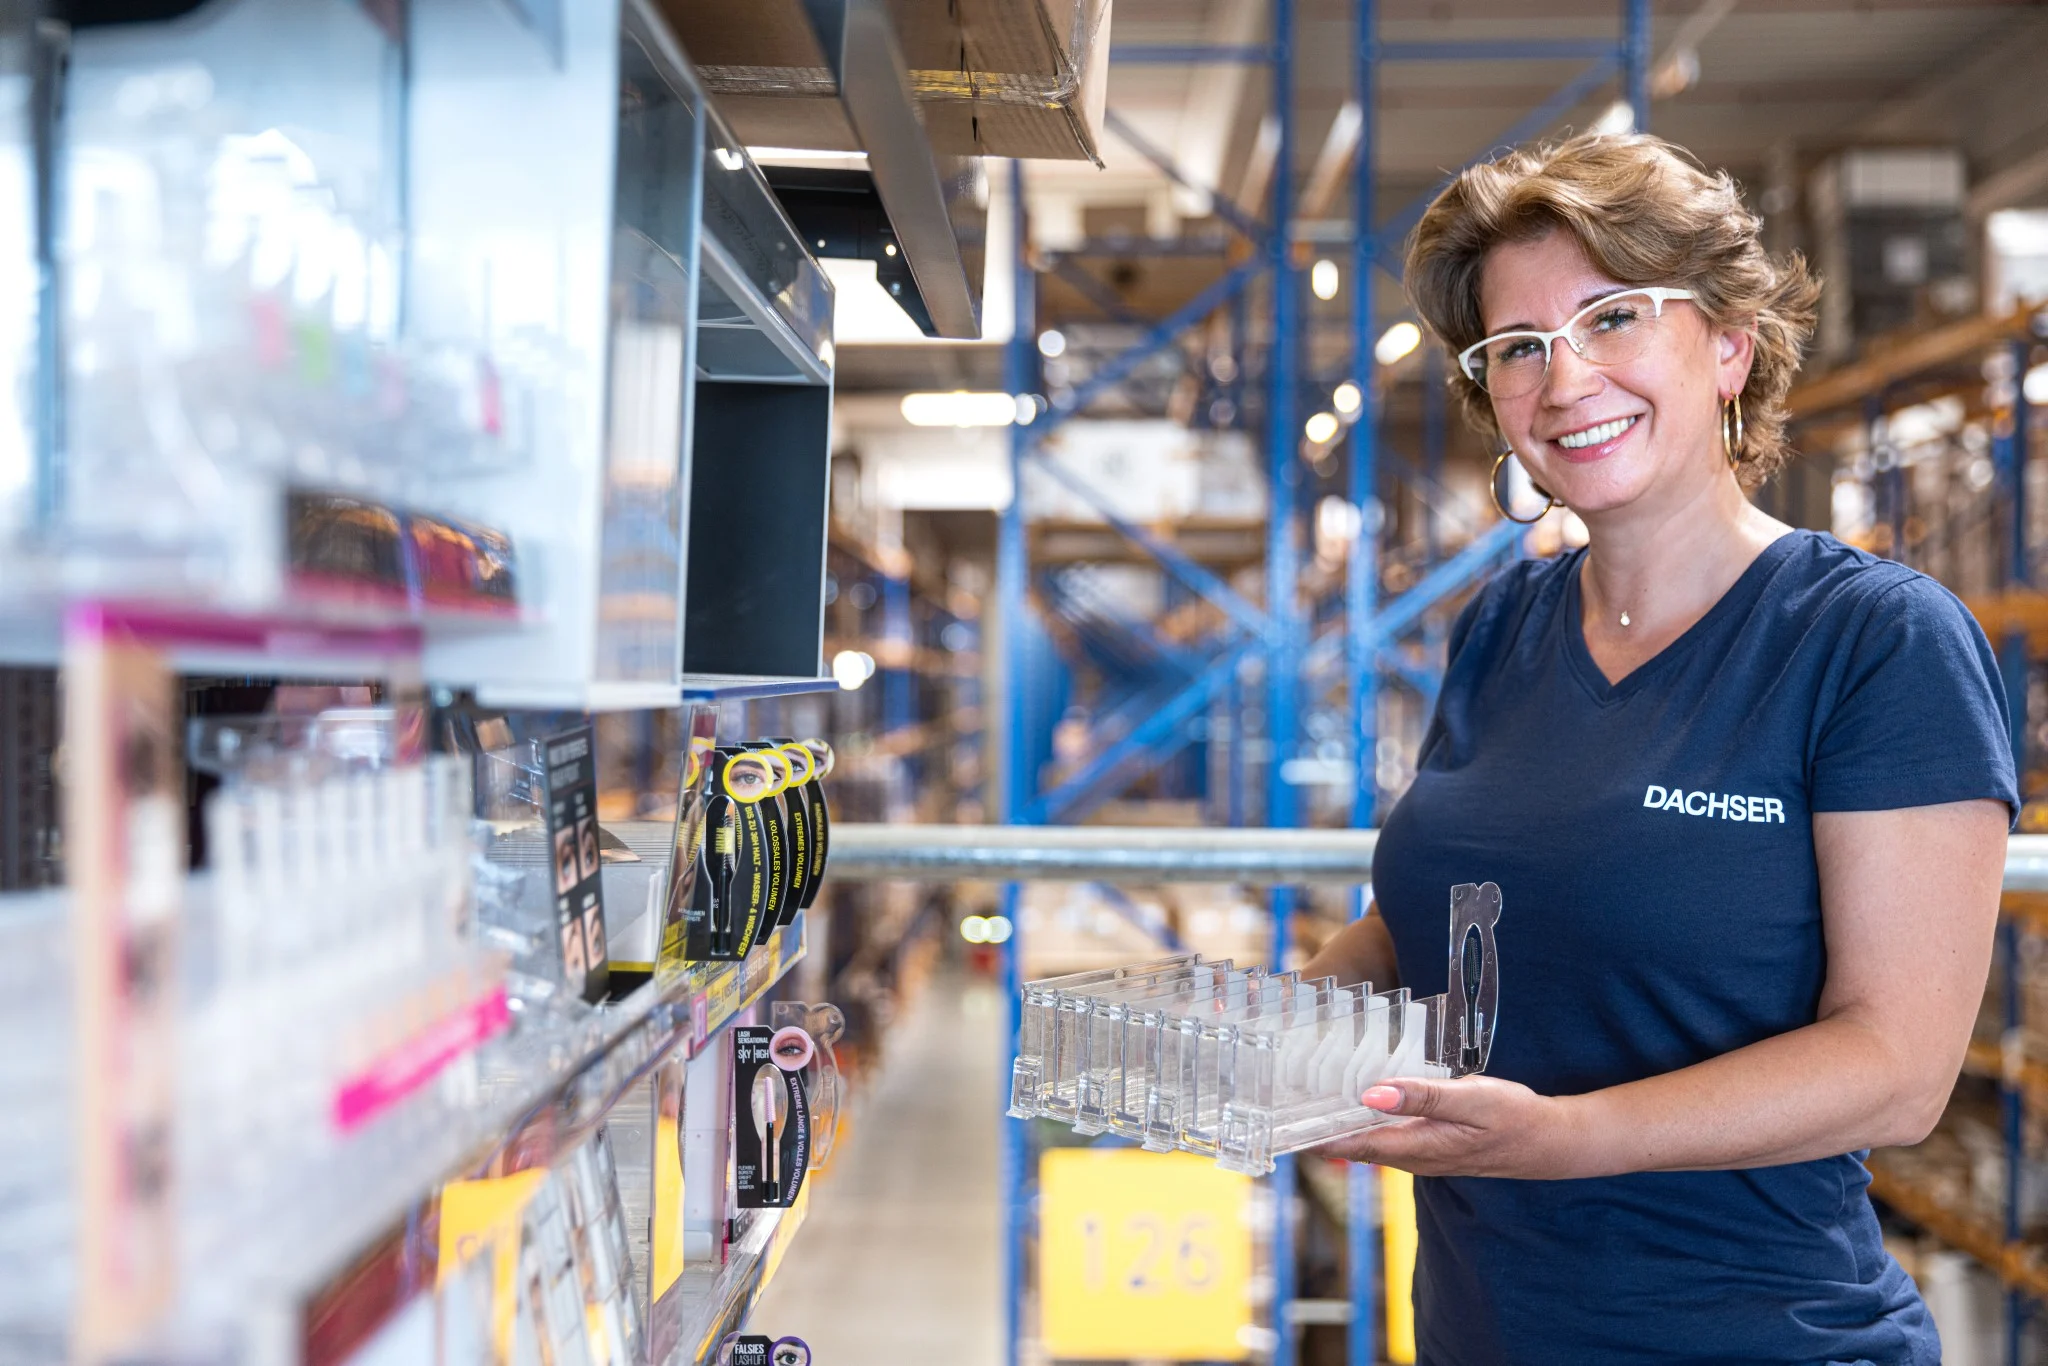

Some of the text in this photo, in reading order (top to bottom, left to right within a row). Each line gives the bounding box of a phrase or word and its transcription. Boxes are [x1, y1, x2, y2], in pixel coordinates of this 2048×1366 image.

[745, 806, 755, 819] BIS
[1643, 785, 1785, 823] DACHSER
[748, 819, 757, 831] ZU
[751, 831, 760, 846] 36H
[753, 846, 761, 866] HALT
[793, 812, 805, 889] EXTREMES VOLUMEN
[767, 819, 781, 911] KOLOSSALES VOLUMEN
[751, 873, 761, 907] WASSER-
[737, 915, 756, 957] WISCHFEST
[738, 1045, 769, 1063] SKY HIGH
[790, 1077, 803, 1110] EXTREME
[796, 1110, 805, 1134] LÄNGE
[795, 1140, 805, 1167] VOLLES
[786, 1168, 801, 1201] VOLUMEN
[1075, 1211, 1224, 1295] 126
[734, 1343, 765, 1354] FALSIES
[734, 1354, 767, 1365] LASH LIFT
